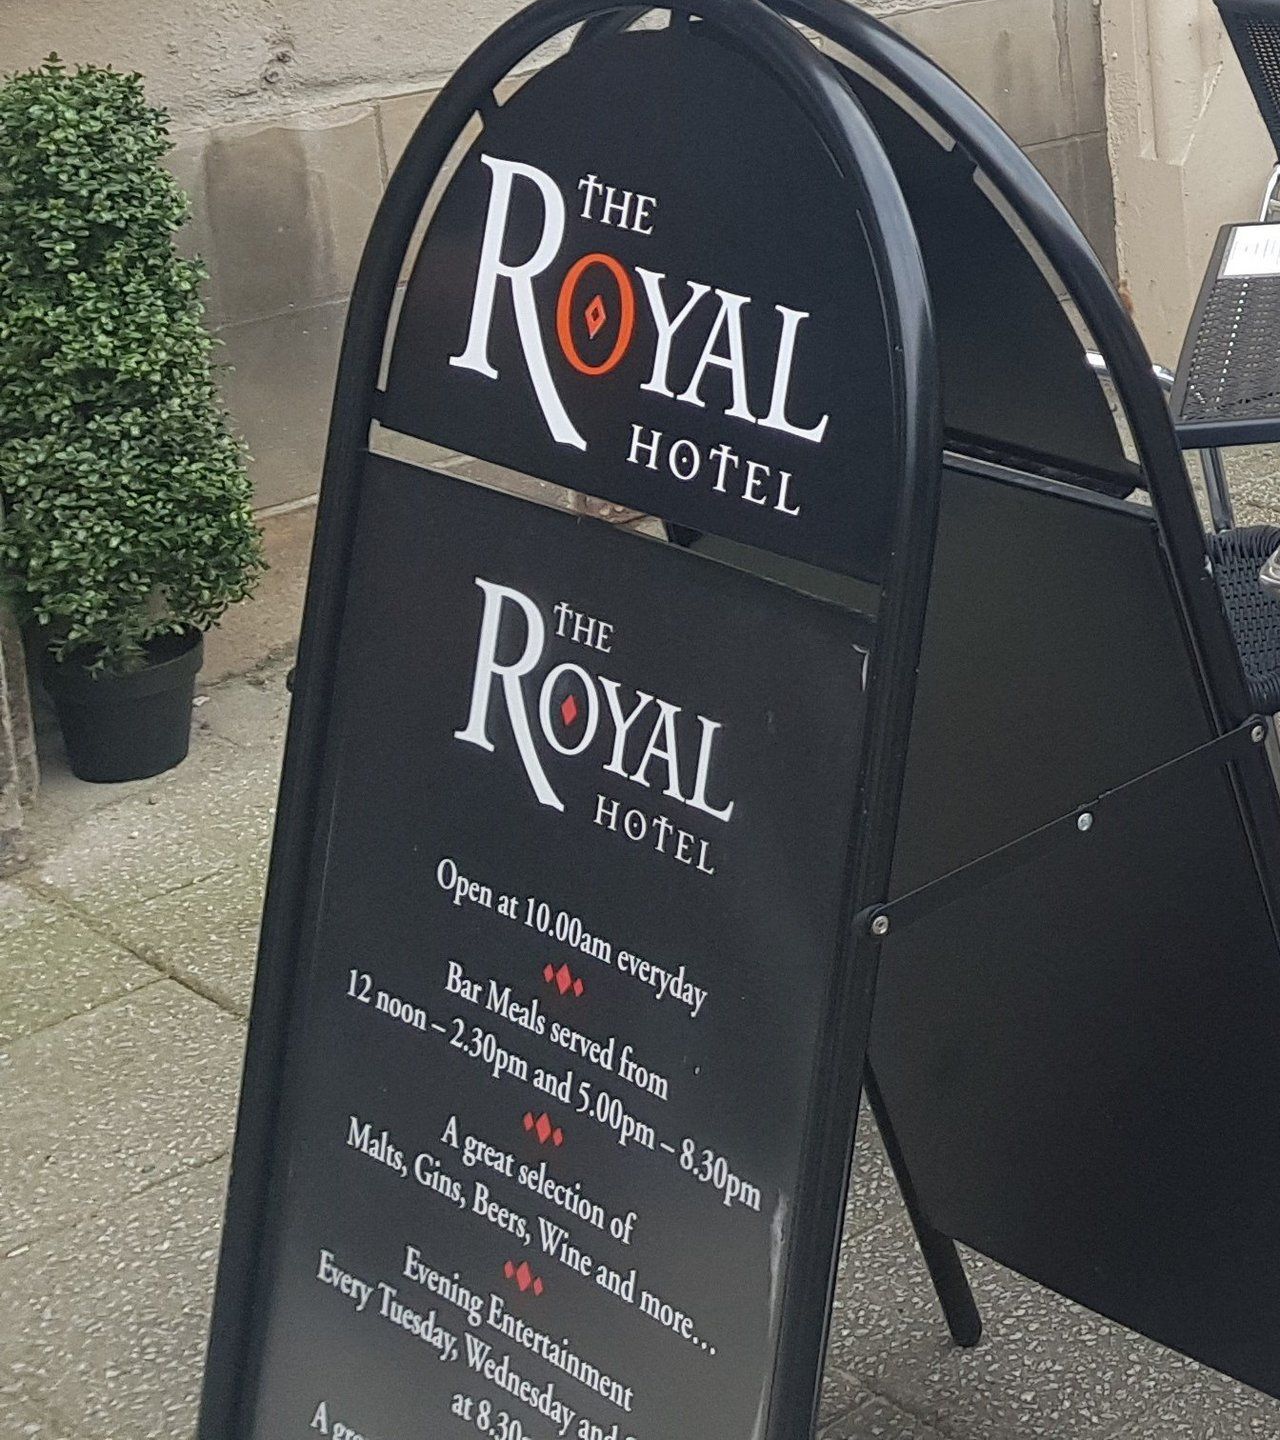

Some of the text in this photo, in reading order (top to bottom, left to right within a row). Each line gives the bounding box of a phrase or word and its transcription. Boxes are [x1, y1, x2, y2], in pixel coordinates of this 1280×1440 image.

[577, 173, 657, 236] THE
[448, 152, 830, 451] ROYAL
[626, 423, 801, 517] HOTEL
[553, 600, 615, 654] THE
[453, 576, 735, 823] ROYAL
[593, 793, 716, 875] HOTEL
[436, 858, 708, 1018] Open at 10.00am everyday
[347, 969, 372, 1003] 12
[374, 991, 427, 1031] noon
[448, 1017, 529, 1081] 2.30pm
[532, 1071, 572, 1105] and
[576, 1082, 656, 1146] 5.00pm
[679, 1137, 762, 1212] 8.30pm
[445, 960, 669, 1101] Bar Meals served from
[346, 1115, 409, 1179] Malts,
[414, 1152, 467, 1211] Gins,
[472, 1181, 532, 1246] Beers,
[537, 1216, 593, 1278] Wine
[595, 1264, 636, 1304] and
[441, 1114, 638, 1247] A great selection of
[316, 1248, 374, 1312] Every
[377, 1282, 459, 1362] Tuesday,
[464, 1333, 576, 1436] Wednesday
[403, 1245, 634, 1412] Evening Entertainment
[309, 1401, 329, 1435] A
[451, 1393, 473, 1421] at
